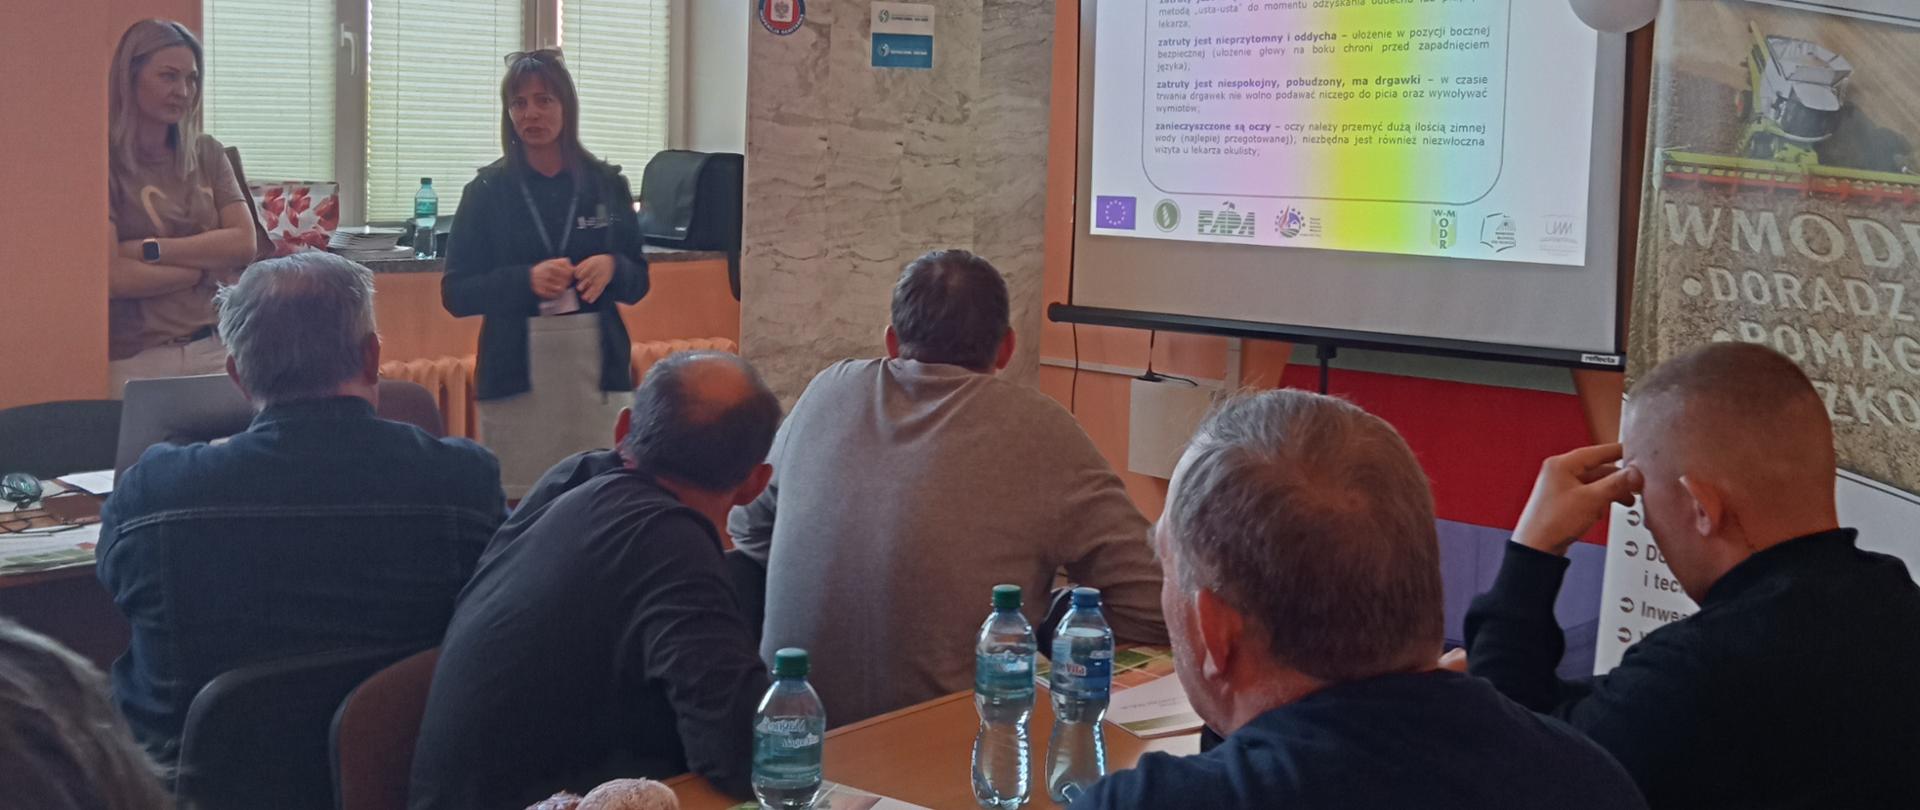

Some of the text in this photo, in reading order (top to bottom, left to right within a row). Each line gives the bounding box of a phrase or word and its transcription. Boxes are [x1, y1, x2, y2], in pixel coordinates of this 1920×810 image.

[1248, 3, 1259, 12] do
[1264, 1, 1307, 11] momentu
[1158, 38, 1191, 47] zatruty
[1194, 36, 1212, 47] jest
[1216, 34, 1283, 45] nieprzytomny
[1294, 32, 1337, 43] oddycha
[1410, 27, 1446, 39] pozycji
[1450, 26, 1490, 38] bocznej
[1158, 50, 1205, 59] bezpiecznej
[1312, 45, 1335, 54] boku
[1343, 43, 1373, 53] chroni
[1382, 42, 1409, 53] przed
[1418, 40, 1489, 51] zapadnięciem
[1157, 80, 1189, 89] zatruty
[1194, 79, 1213, 89] jest
[1218, 78, 1280, 89] niespokojny,
[1286, 77, 1345, 88] pobudzony,
[1352, 78, 1368, 86] ma
[1375, 75, 1421, 87] drgawki
[1441, 76, 1449, 84] w
[1455, 75, 1488, 84] czasie
[1157, 92, 1186, 100] trwania
[1190, 91, 1225, 101] drgawek
[1246, 91, 1272, 99] wolno
[1275, 90, 1315, 100] podawać
[1319, 91, 1355, 100] niczego
[1359, 90, 1371, 98] do
[1375, 89, 1397, 99] picia
[1402, 90, 1424, 98] oraz
[1429, 87, 1487, 99] wywoływać
[1155, 122, 1231, 132] zanieczyszczone
[1235, 124, 1245, 132] są
[1249, 124, 1271, 132] oczy
[1284, 124, 1304, 132] oczy
[1342, 121, 1383, 133] przemyć
[1387, 122, 1411, 133] dużą
[1415, 122, 1446, 133] ilością
[1450, 123, 1486, 134] zimnej
[1155, 134, 1176, 143] wody
[1181, 134, 1220, 144] (najlepiej
[1302, 135, 1349, 146] niezbędna
[1353, 135, 1373, 146] jest
[1422, 136, 1485, 146] niezwłoczna
[1154, 146, 1181, 155] wizyta
[1191, 146, 1221, 154] lekarza
[1433, 209, 1456, 217] W-M
[1198, 209, 1255, 236] FAPA
[1708, 267, 1914, 321] DORADZ
[1644, 570, 1684, 593] i tec
